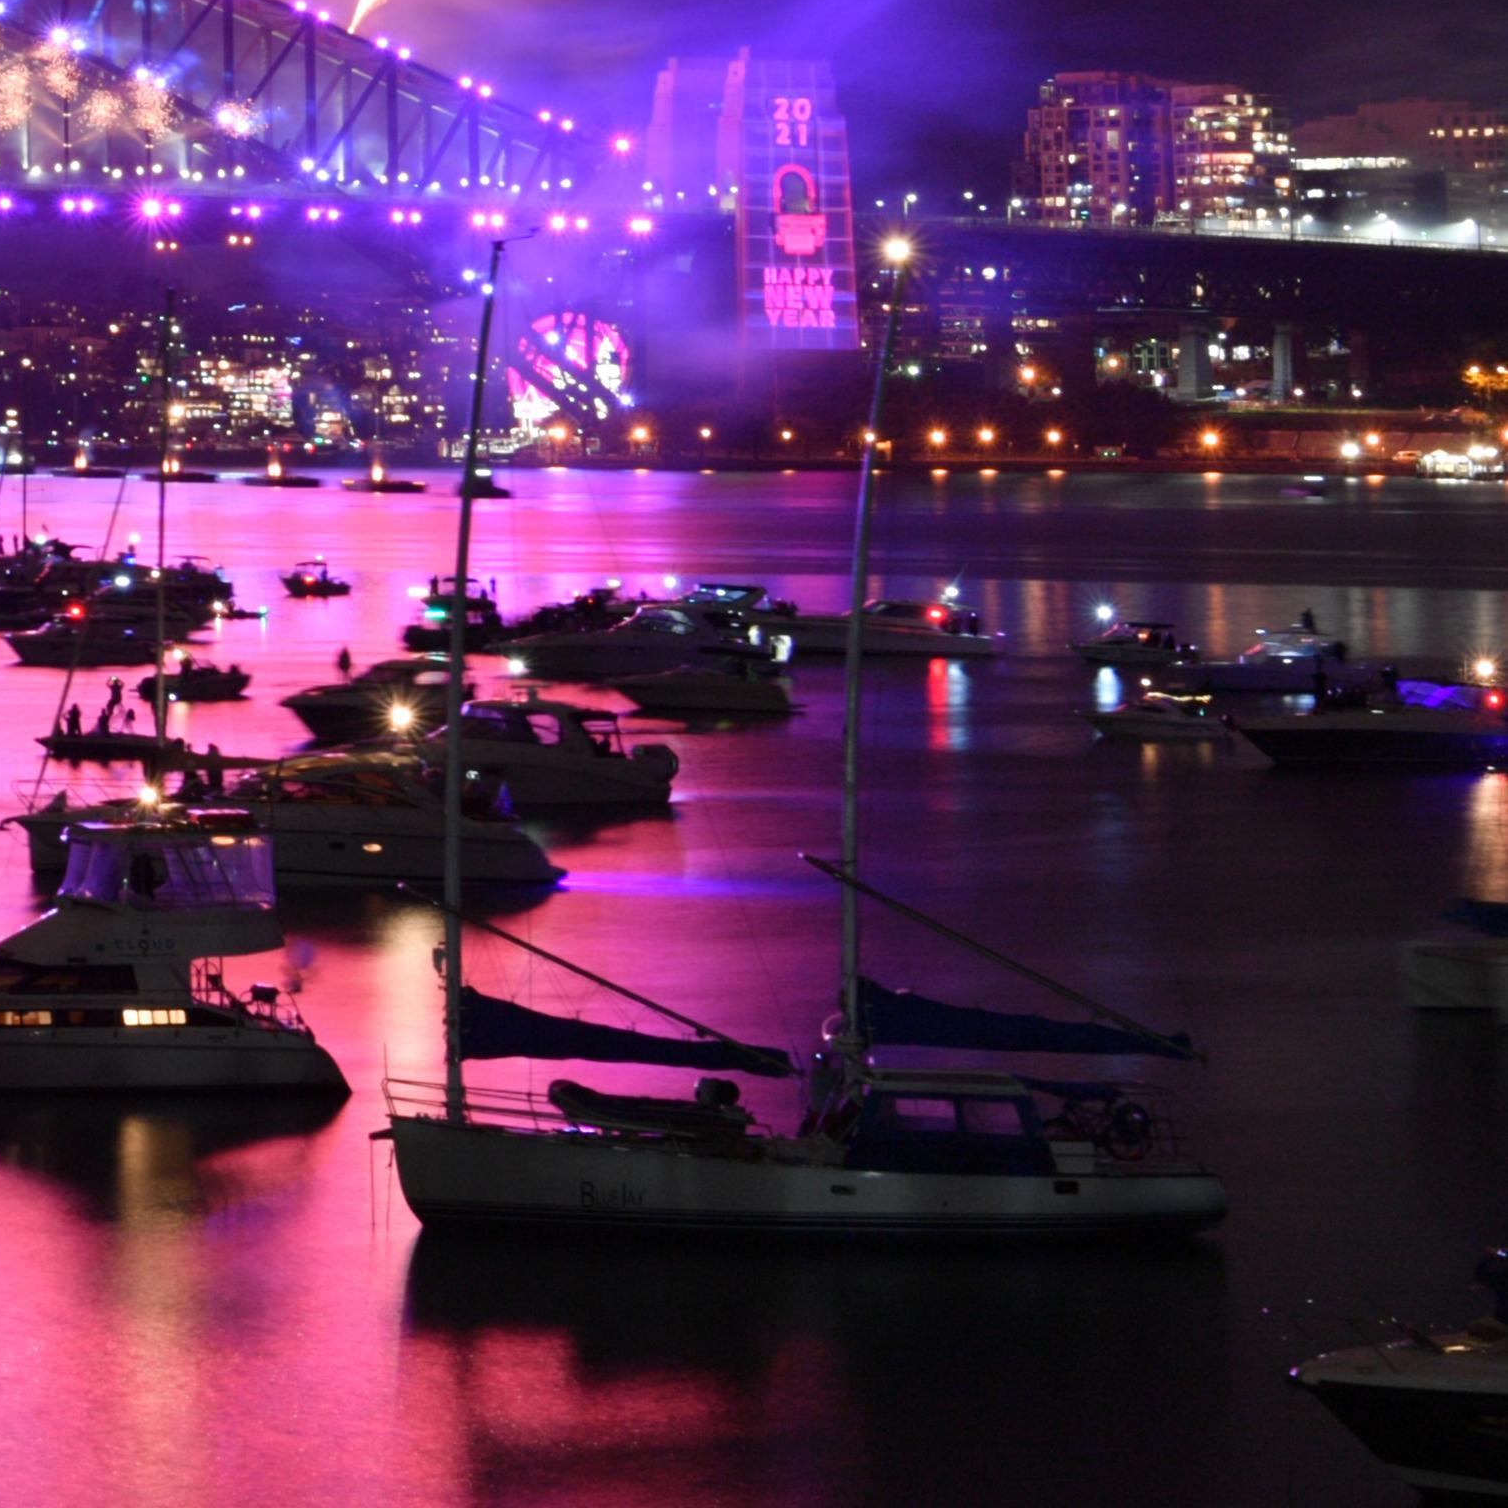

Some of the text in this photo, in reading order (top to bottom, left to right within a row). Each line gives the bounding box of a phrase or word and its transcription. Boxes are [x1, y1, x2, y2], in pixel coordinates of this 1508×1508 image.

[773, 98, 812, 120] 20
[776, 122, 808, 146] 21
[763, 267, 833, 285] HAPPY
[763, 285, 834, 309] NEW
[764, 309, 836, 327] YEAR
